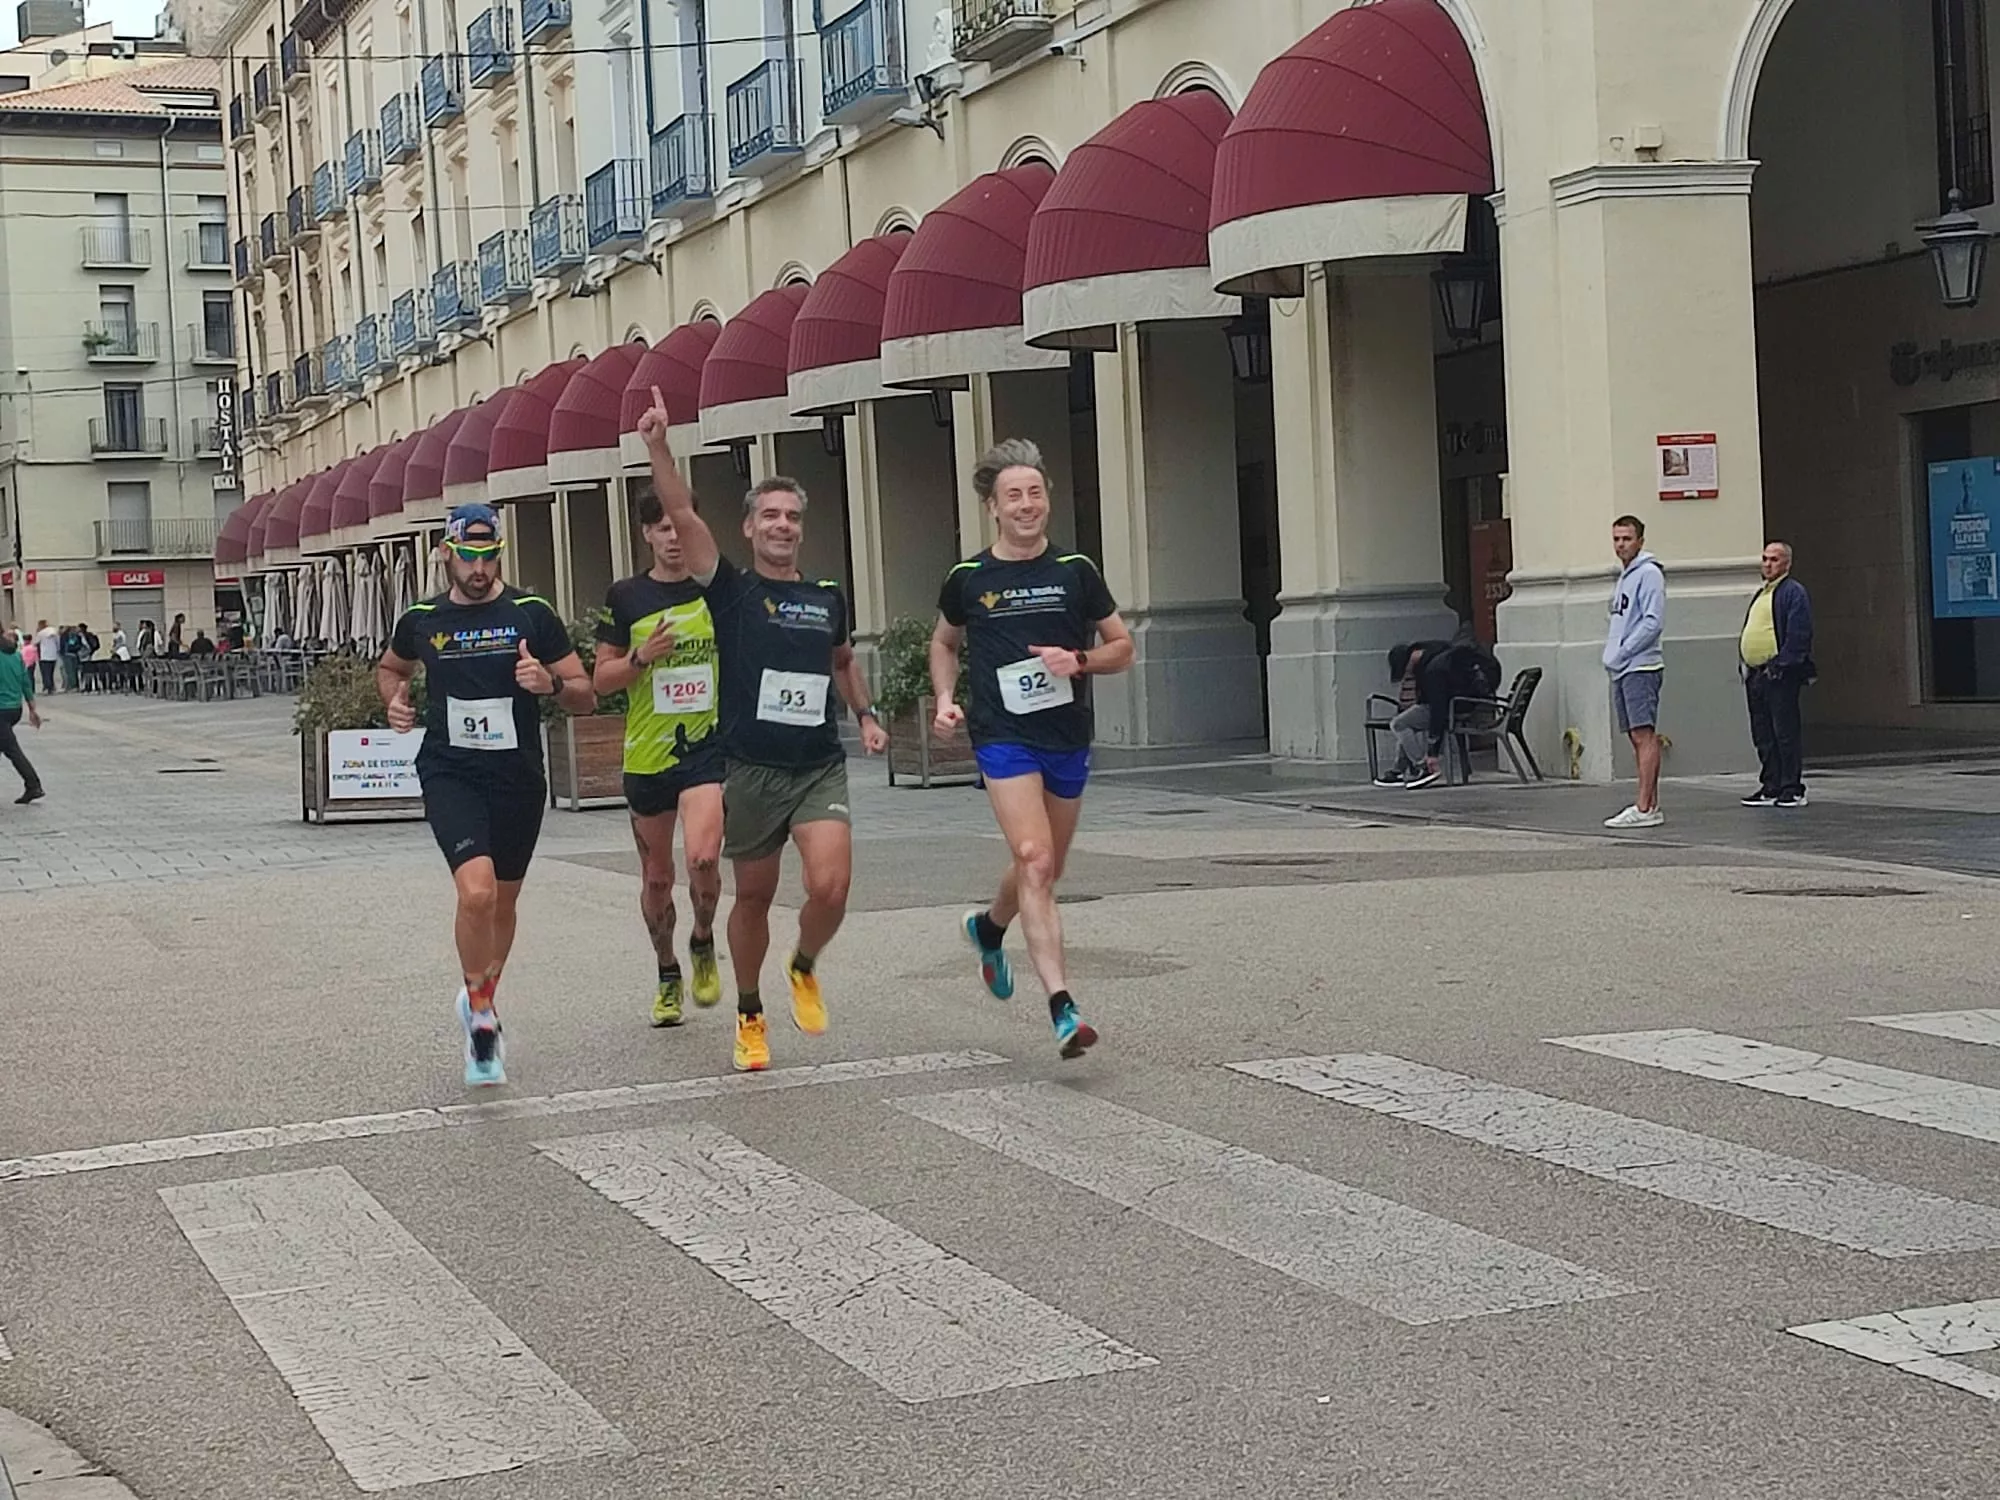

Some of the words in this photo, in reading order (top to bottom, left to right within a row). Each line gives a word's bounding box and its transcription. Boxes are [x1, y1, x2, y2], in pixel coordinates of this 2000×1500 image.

[217, 378, 234, 471] HOSTAL
[123, 573, 150, 584] GAES
[662, 680, 707, 698] 1202
[1019, 671, 1049, 692] 92
[780, 688, 806, 707] 93
[463, 716, 489, 733] 91
